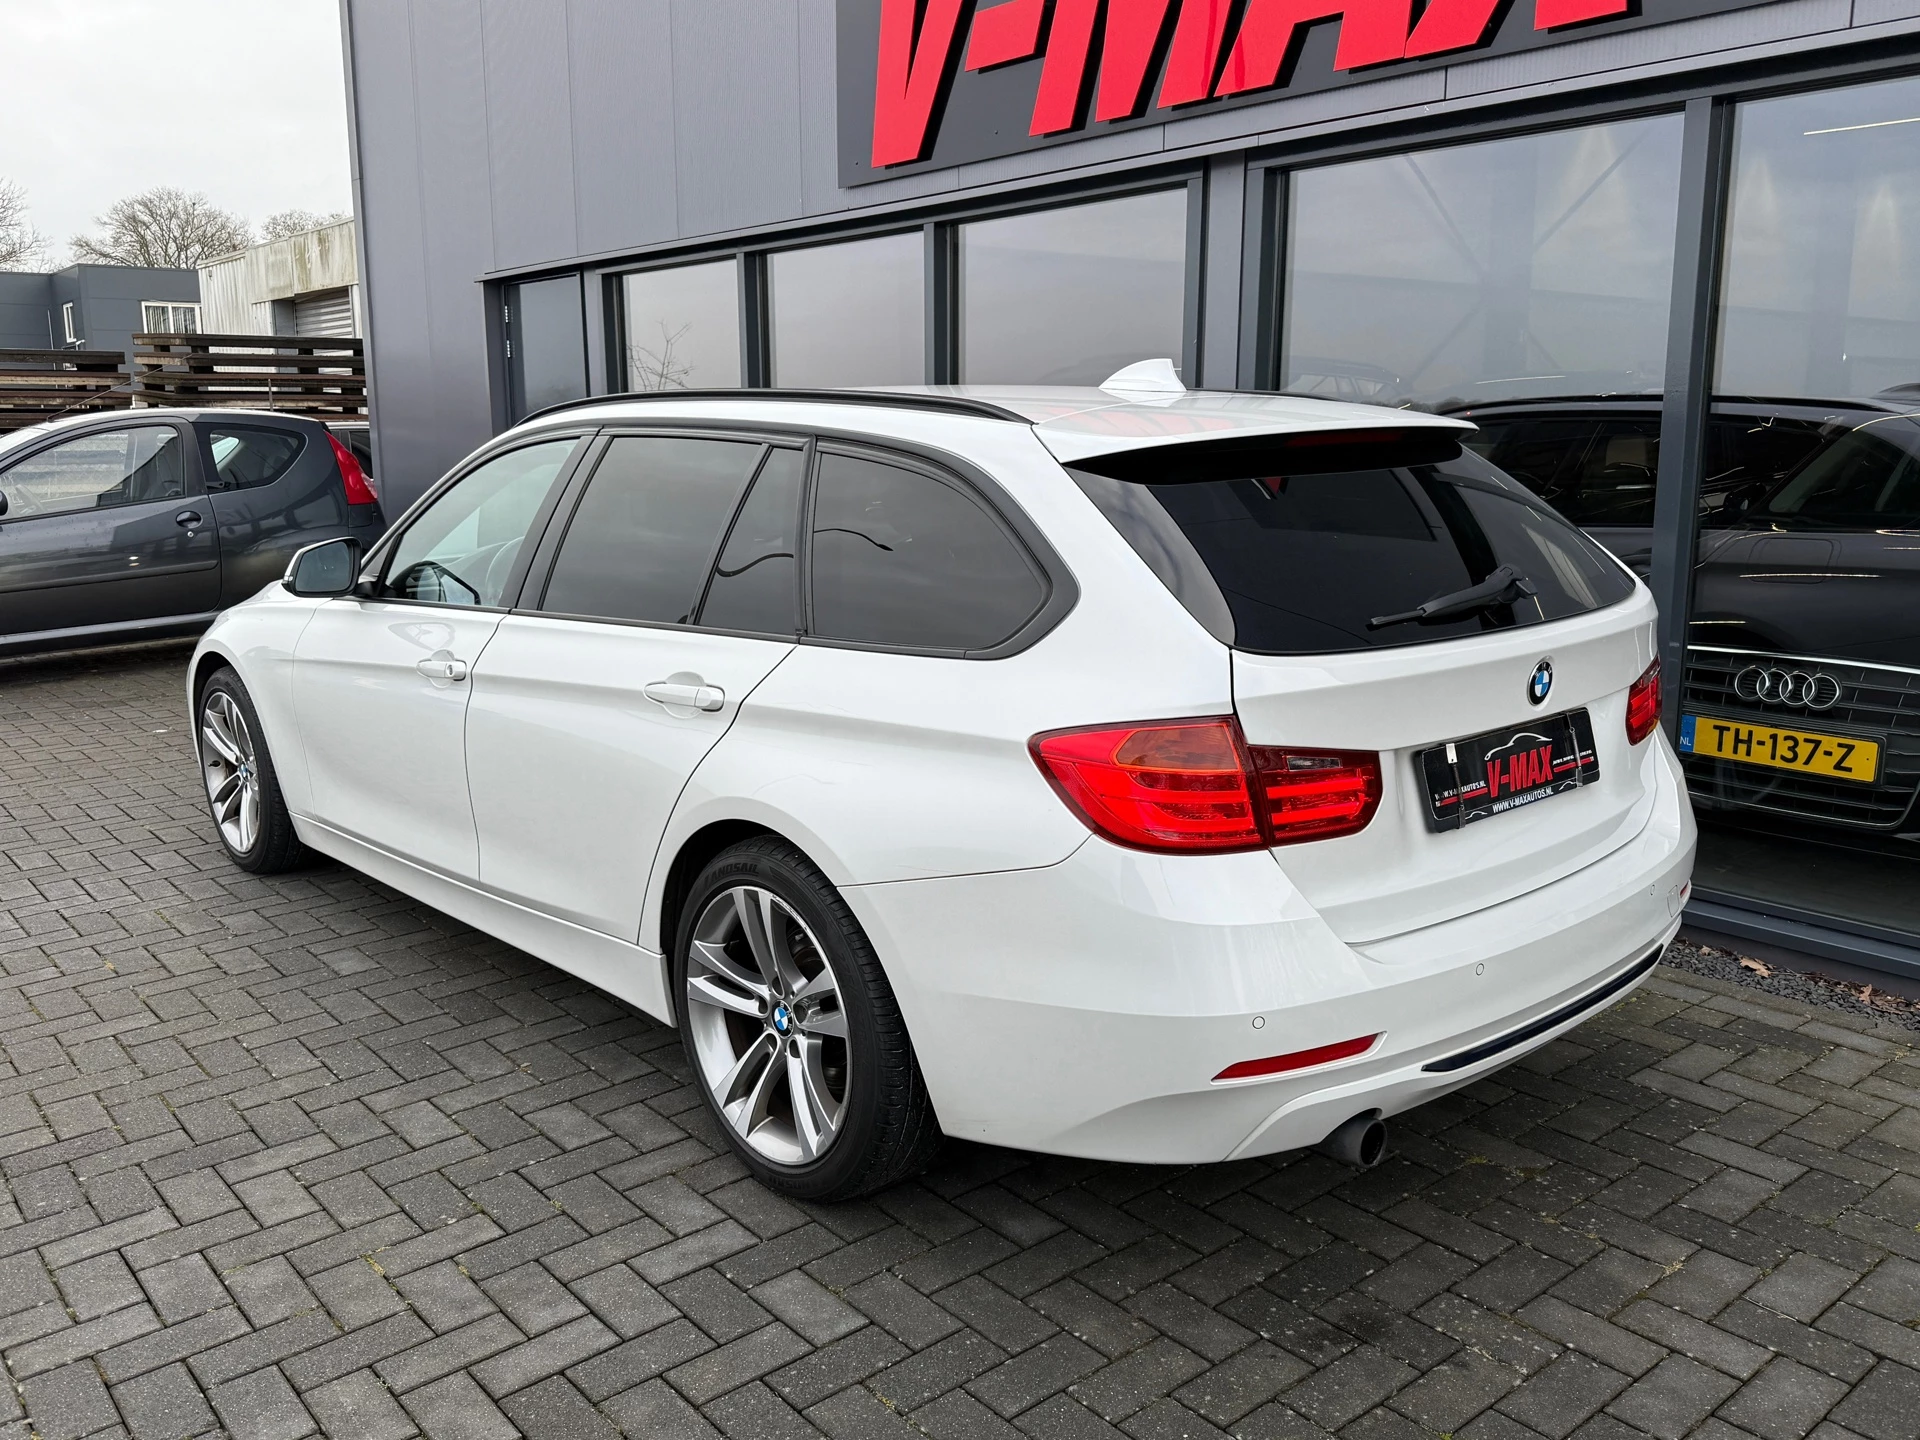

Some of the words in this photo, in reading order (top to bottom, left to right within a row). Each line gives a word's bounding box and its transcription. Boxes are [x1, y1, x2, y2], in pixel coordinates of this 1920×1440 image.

[872, 0, 1627, 168] V-M
[1679, 735, 1692, 747] NL
[1712, 724, 1856, 773] TH-137-Z
[1486, 744, 1554, 798] V-MAX
[1492, 787, 1554, 814] WWW.V-MAXAUTOS.NL
